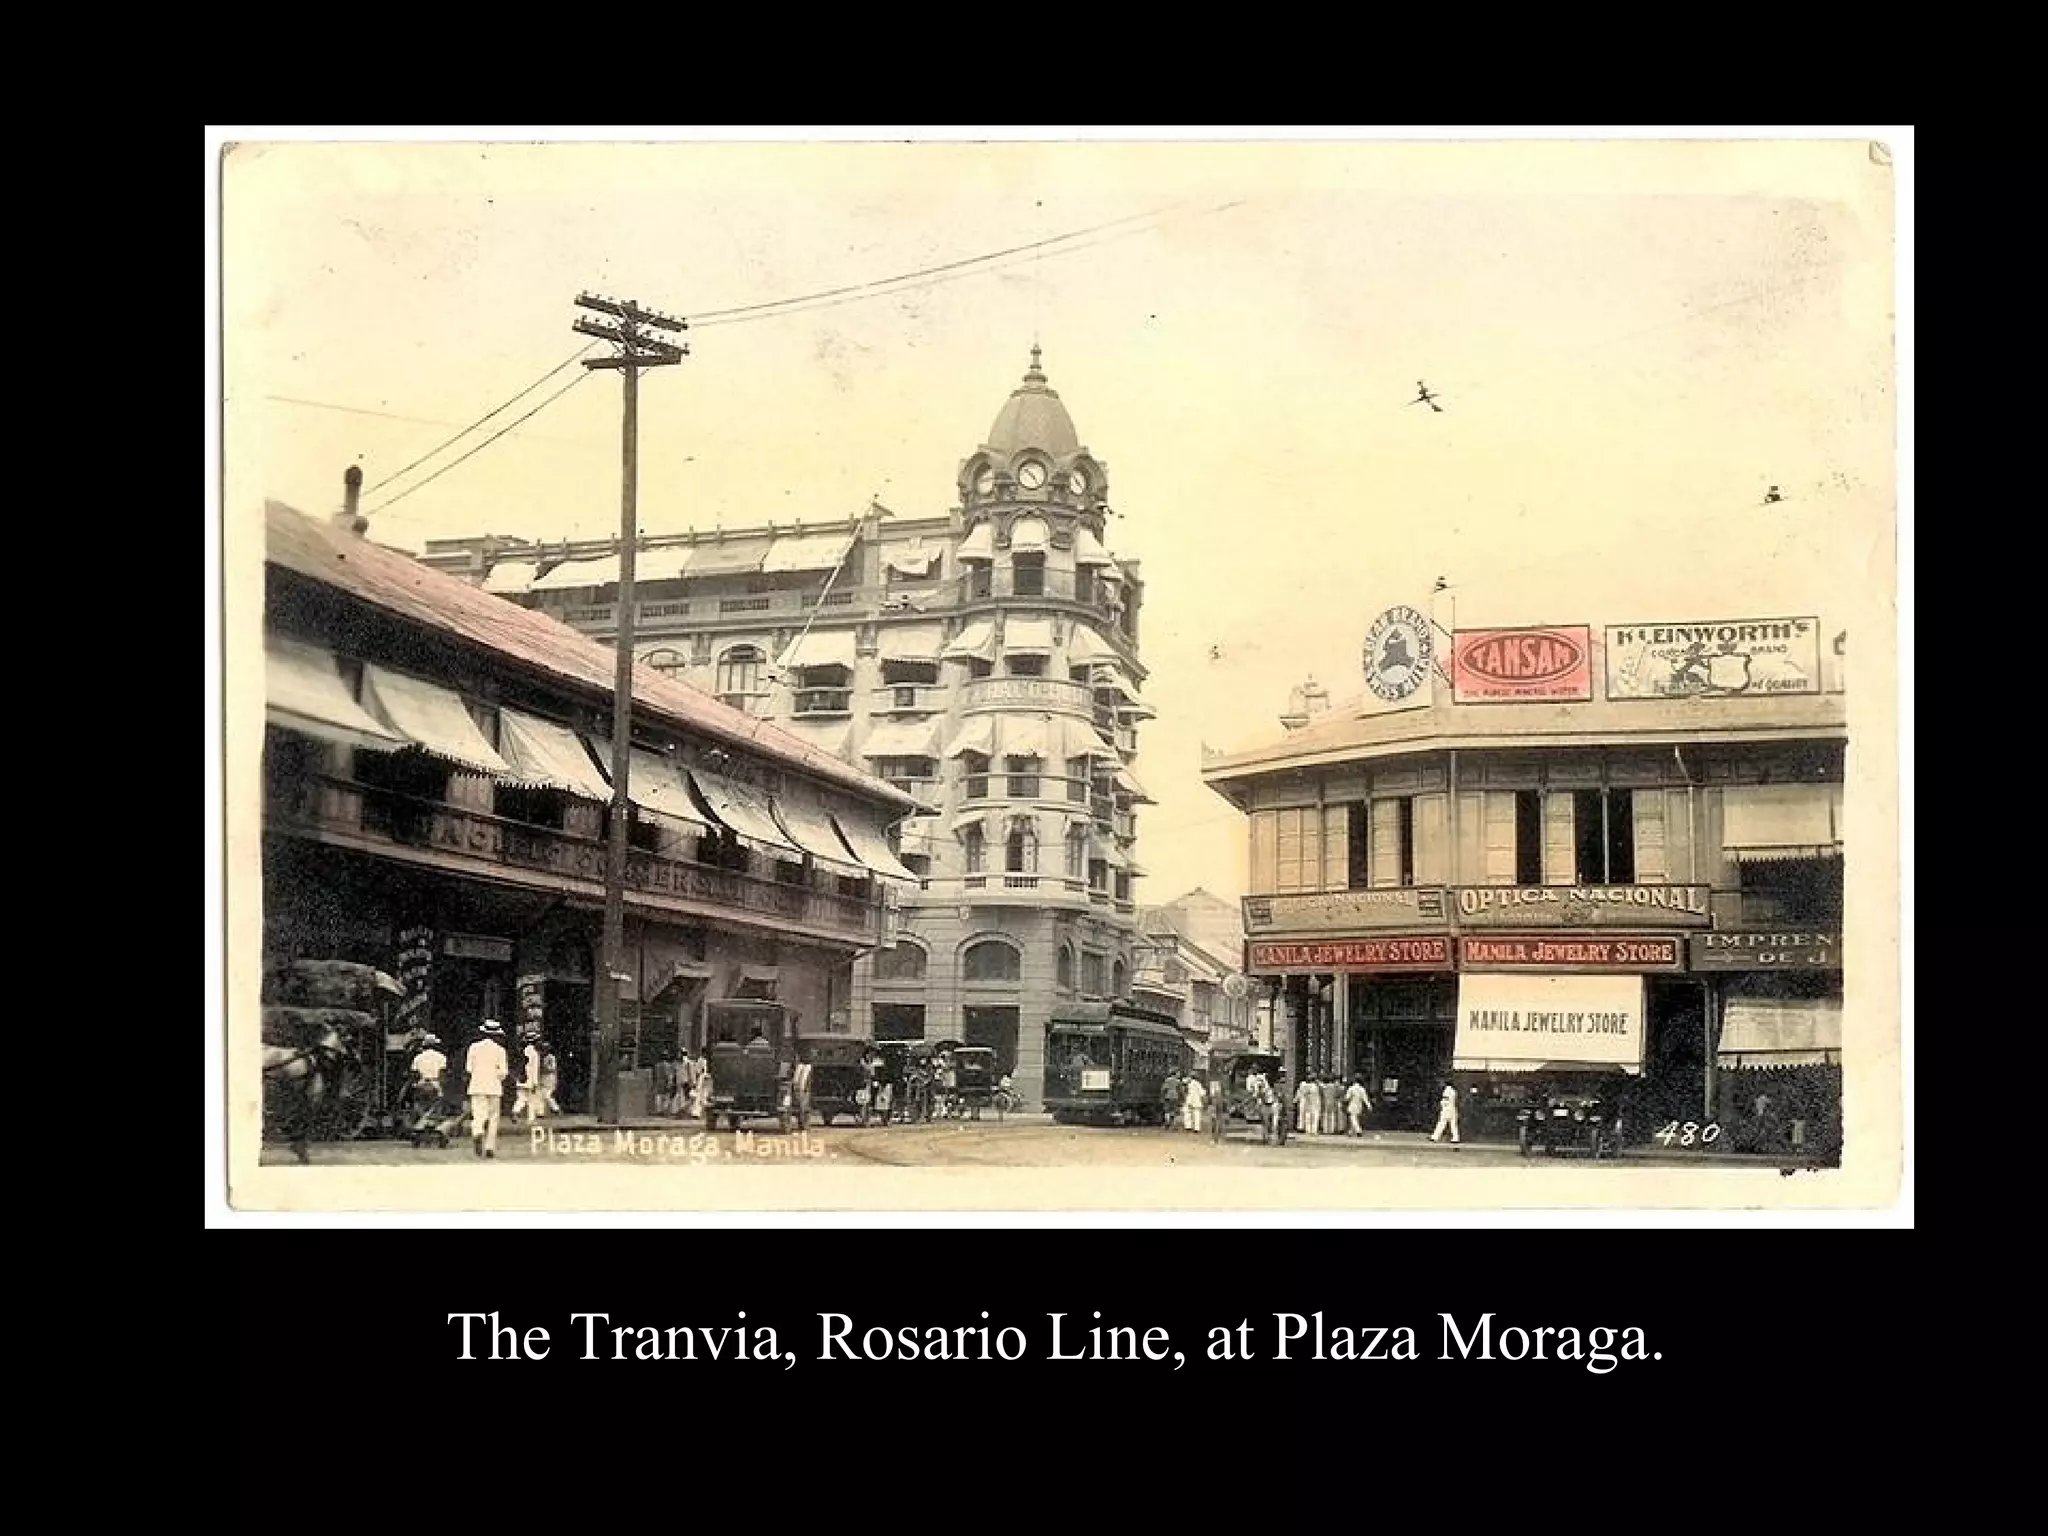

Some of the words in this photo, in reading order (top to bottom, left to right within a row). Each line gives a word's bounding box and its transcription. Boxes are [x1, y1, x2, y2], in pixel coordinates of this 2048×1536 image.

[1471, 638, 1571, 677] TANSAN
[1459, 888, 1557, 914] OPTICA
[1569, 888, 1705, 915] NACIONAL
[1255, 945, 1312, 964] MANILA
[1313, 944, 1387, 963] JEWELRY
[1388, 941, 1446, 961] STORE
[1467, 942, 1526, 961] MANILA
[1532, 942, 1611, 962] JEWELRY
[1616, 942, 1673, 962] STORE
[1469, 1010, 1520, 1031] MANILA
[1523, 1012, 1584, 1033] JEWELRY
[1587, 1012, 1629, 1035] STORE
